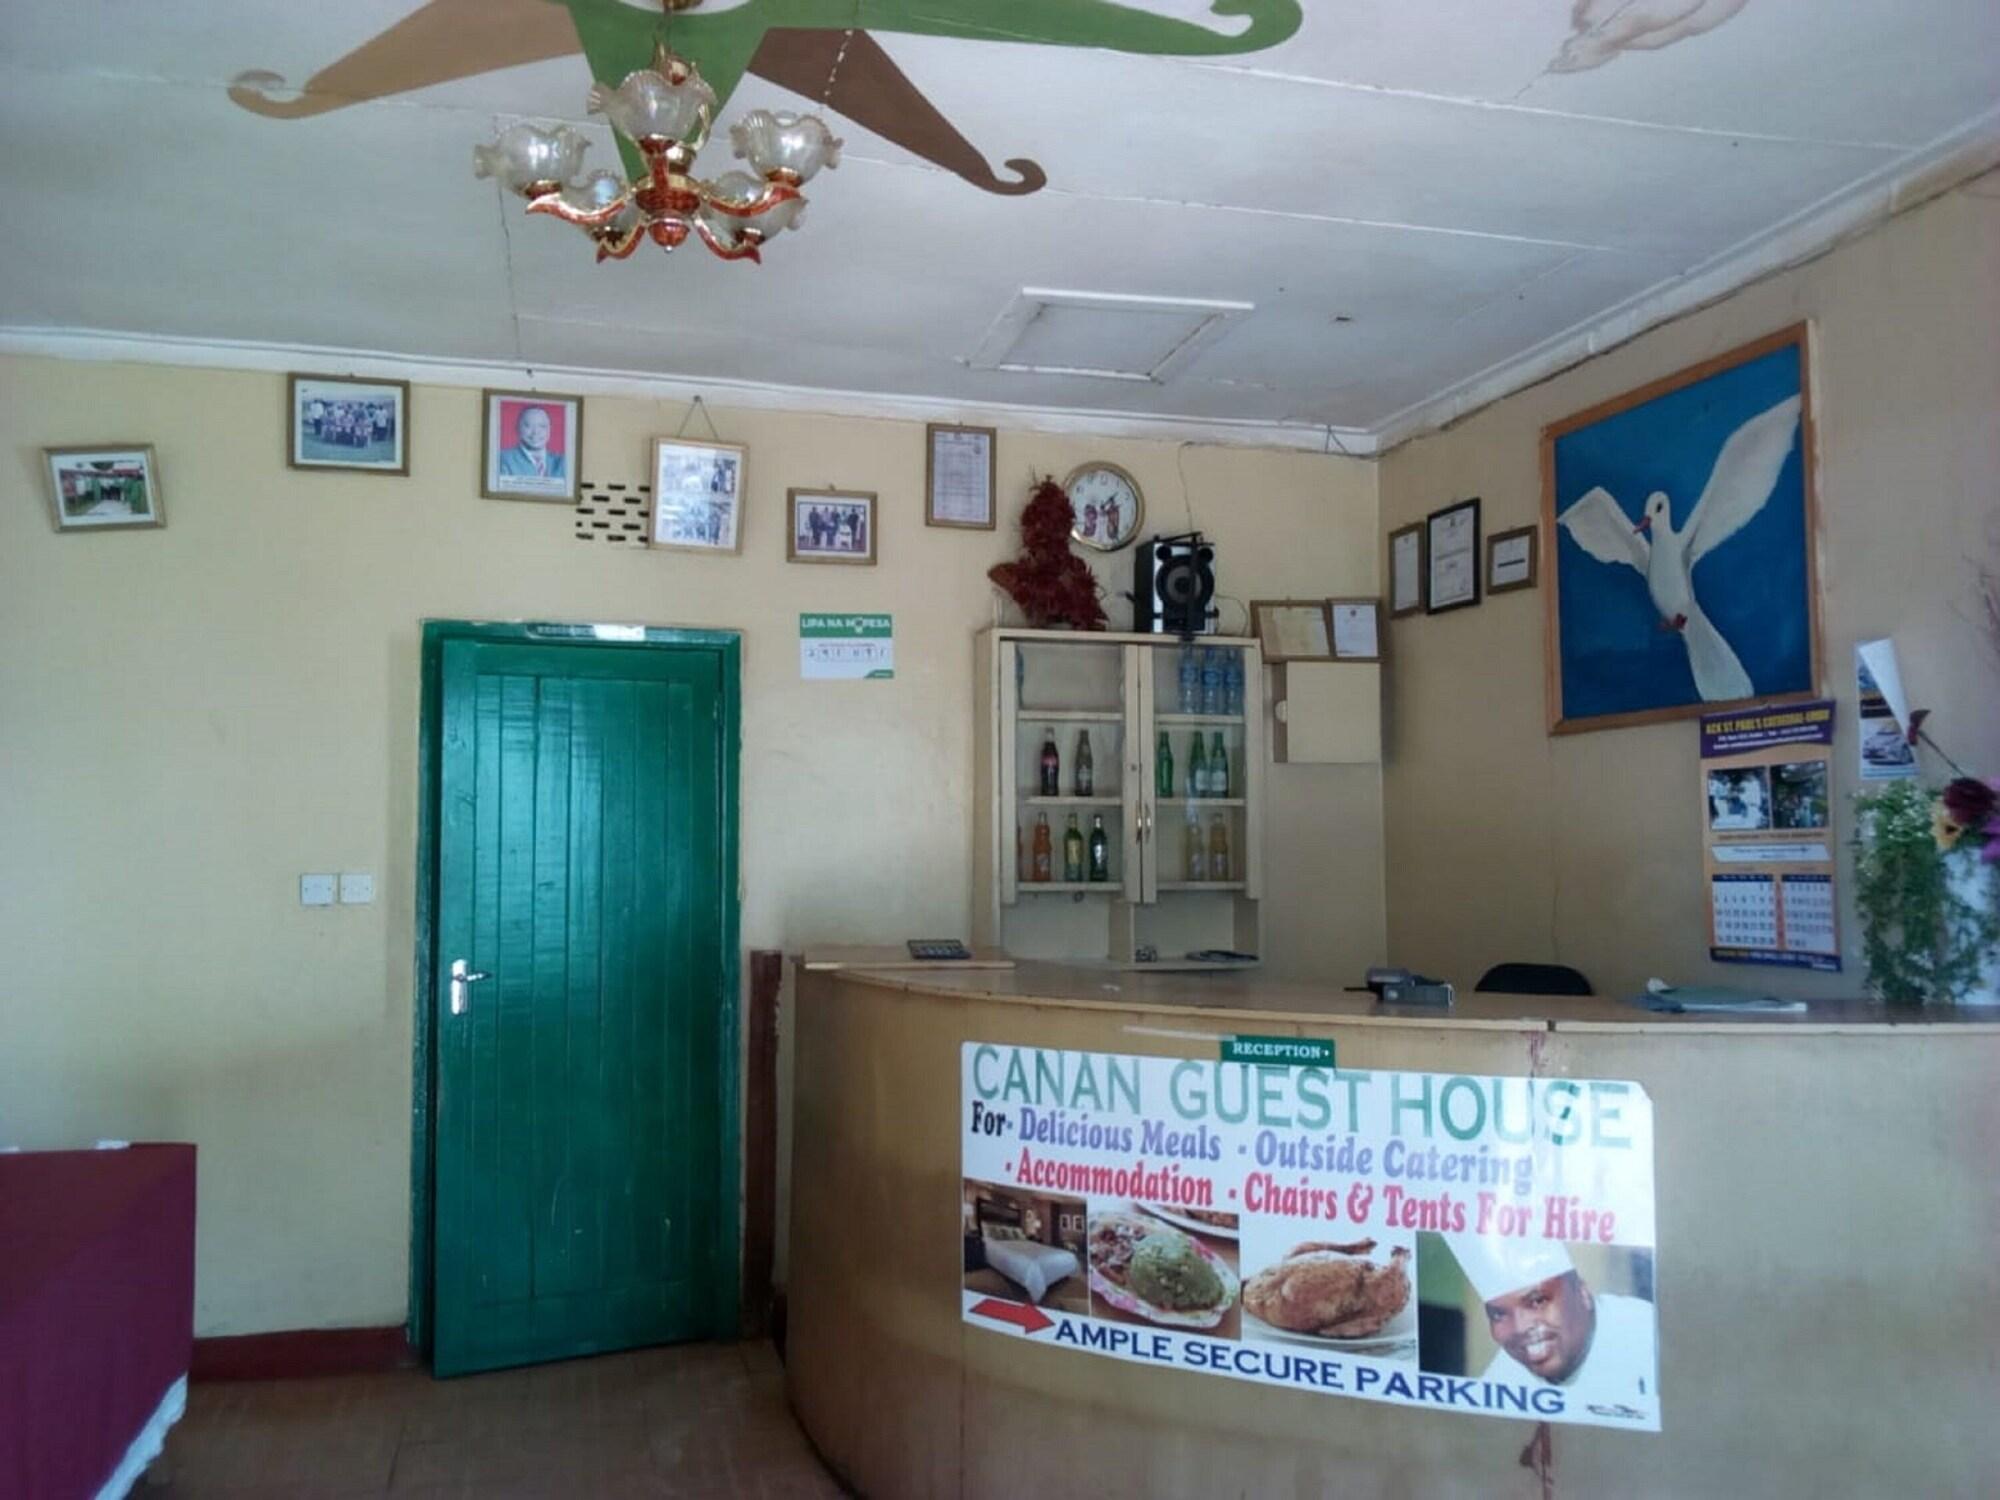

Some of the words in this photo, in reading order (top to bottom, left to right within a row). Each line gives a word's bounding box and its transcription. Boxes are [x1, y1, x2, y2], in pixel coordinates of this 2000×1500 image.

[973, 1045, 1142, 1116] CANAN
[1169, 1060, 1372, 1133] GUEST
[1391, 1074, 1631, 1148] HOUSE
[1232, 1042, 1321, 1059] RECEPTION
[1016, 1146, 1213, 1207] Accommodation
[1244, 1171, 1338, 1221] Chairs
[1346, 1181, 1374, 1224] &
[1383, 1184, 1467, 1233] Tents
[1475, 1191, 1533, 1242] For
[1542, 1195, 1617, 1244] Hire
[1018, 1106, 1133, 1154] Delicious
[1140, 1119, 1222, 1161] Meals
[1254, 1129, 1373, 1176] Outside
[1382, 1139, 1535, 1196] Catering
[1055, 1319, 1174, 1362] AMPLE
[1183, 1340, 1345, 1390] SECURE
[1355, 1365, 1566, 1415] PARKING
